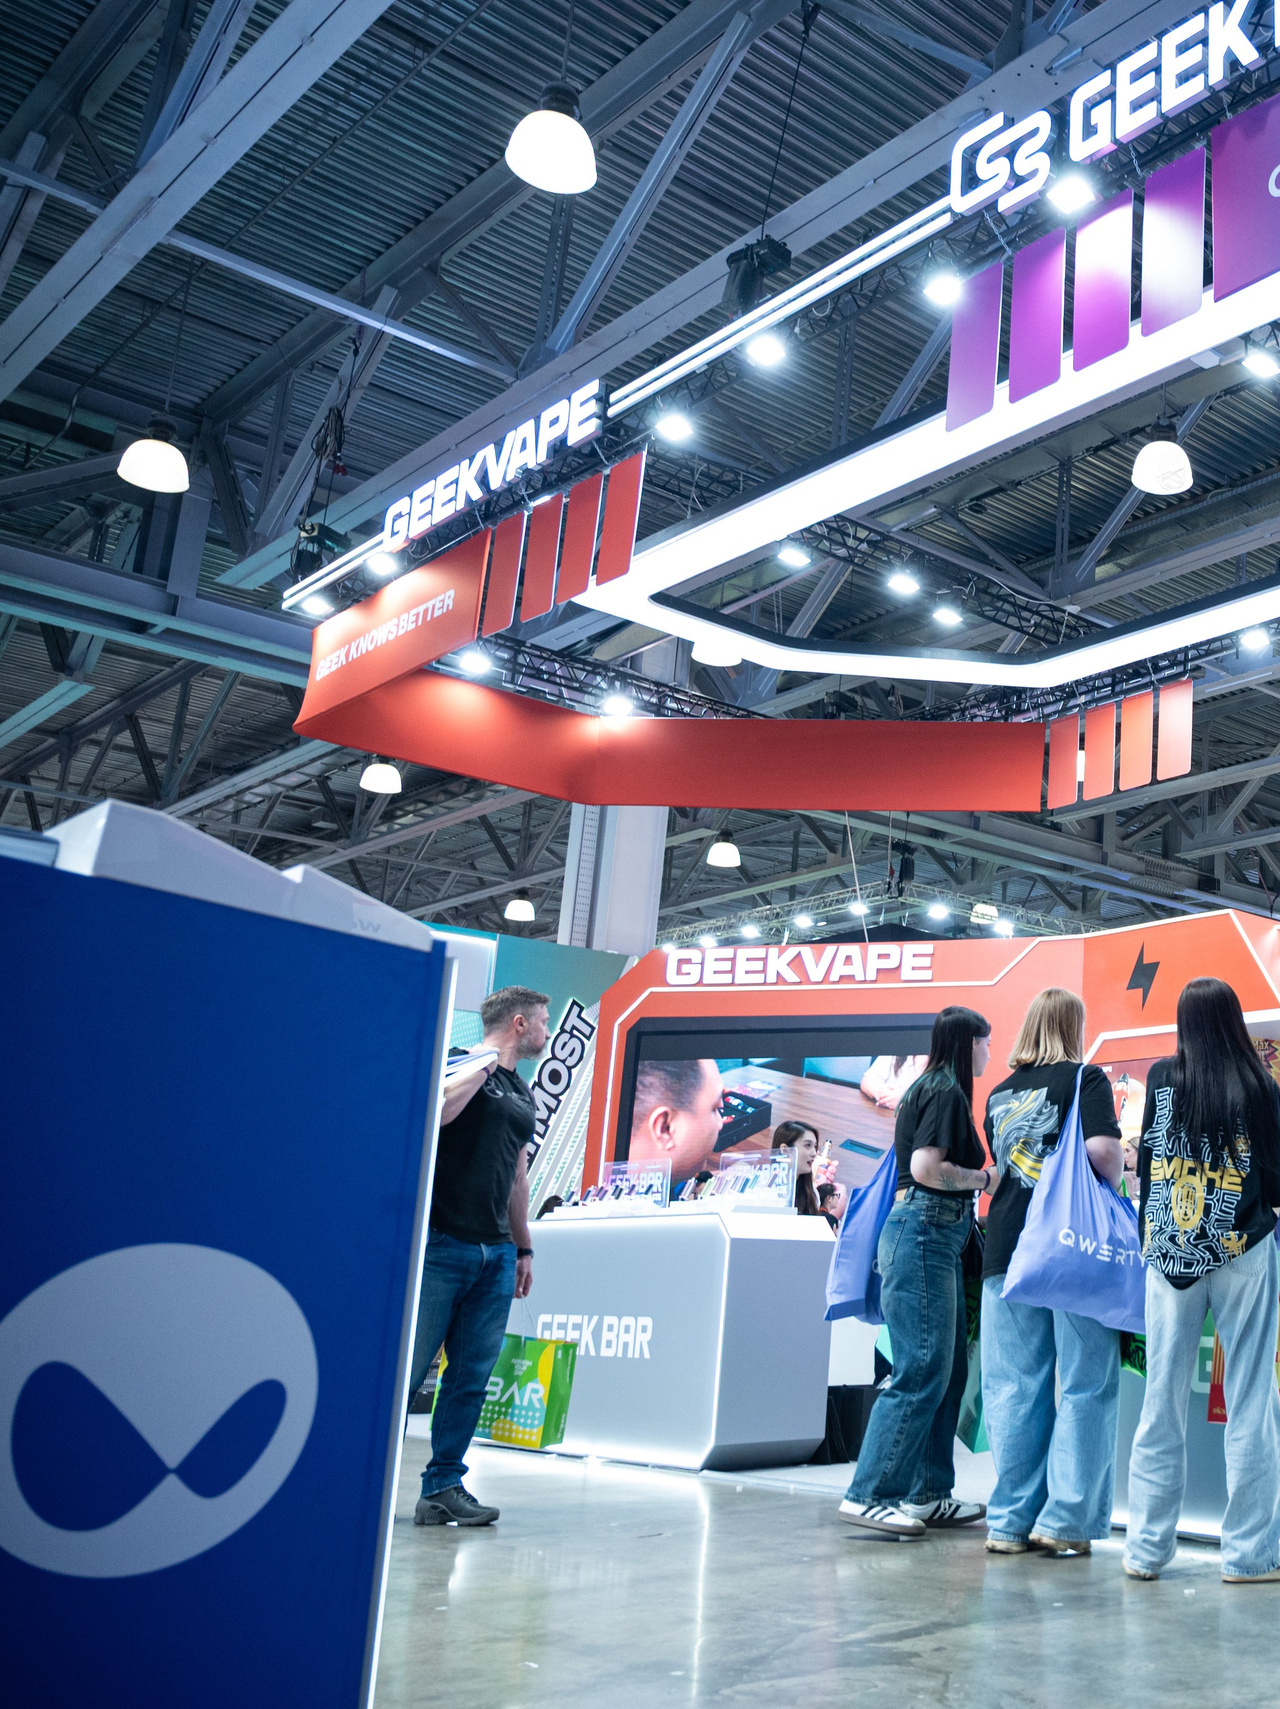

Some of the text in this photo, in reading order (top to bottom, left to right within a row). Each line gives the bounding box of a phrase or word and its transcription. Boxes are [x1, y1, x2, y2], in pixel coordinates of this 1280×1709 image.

[1069, 0, 1260, 162] GEEK
[382, 378, 601, 552] GEEKVAPE
[316, 589, 455, 681] GEEK KNOWS BETTER
[666, 944, 934, 985] GEEKVAPE
[1058, 1227, 1147, 1268] QWERTY
[600, 1315, 653, 1360] BAR
